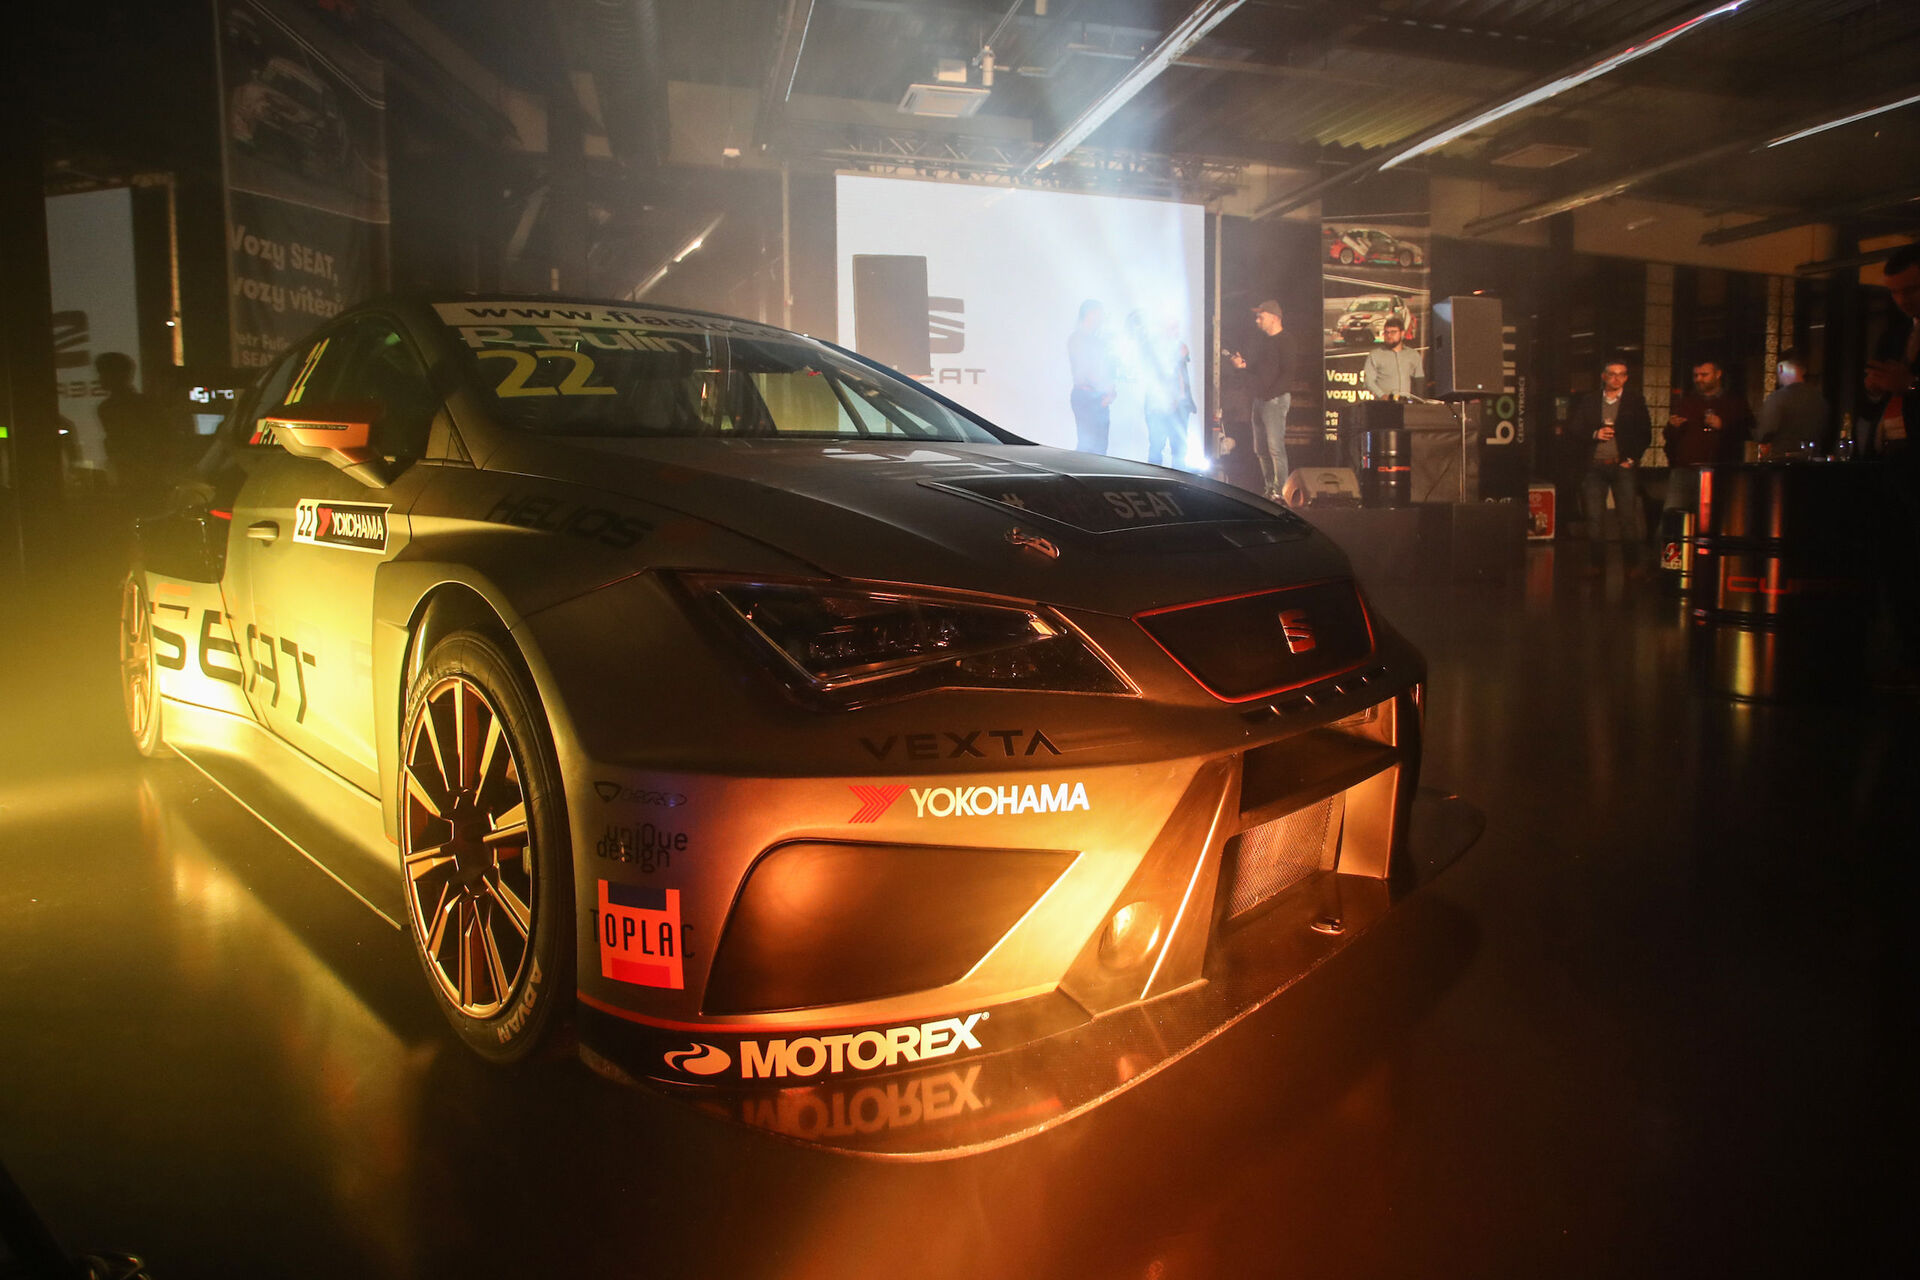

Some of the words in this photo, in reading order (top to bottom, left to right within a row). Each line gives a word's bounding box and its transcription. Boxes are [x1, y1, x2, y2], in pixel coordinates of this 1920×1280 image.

[230, 224, 285, 271] Vozy
[291, 242, 338, 286] SEAT,
[231, 277, 285, 312] vozy
[459, 326, 531, 348] P.
[476, 350, 618, 398] 22
[1326, 369, 1358, 385] Vozy
[1326, 390, 1356, 403] vozy
[483, 495, 654, 550] HELIOS
[1103, 491, 1185, 518] SEAT
[297, 505, 313, 537] 22
[332, 512, 384, 541] YOKOHAMA
[149, 602, 317, 725] SEAT
[858, 729, 1063, 761] VEXTA
[909, 782, 1091, 818] YOKOHAMA
[596, 840, 670, 874] design
[590, 908, 695, 958] TOPLAC
[496, 956, 543, 1045] ADVAN
